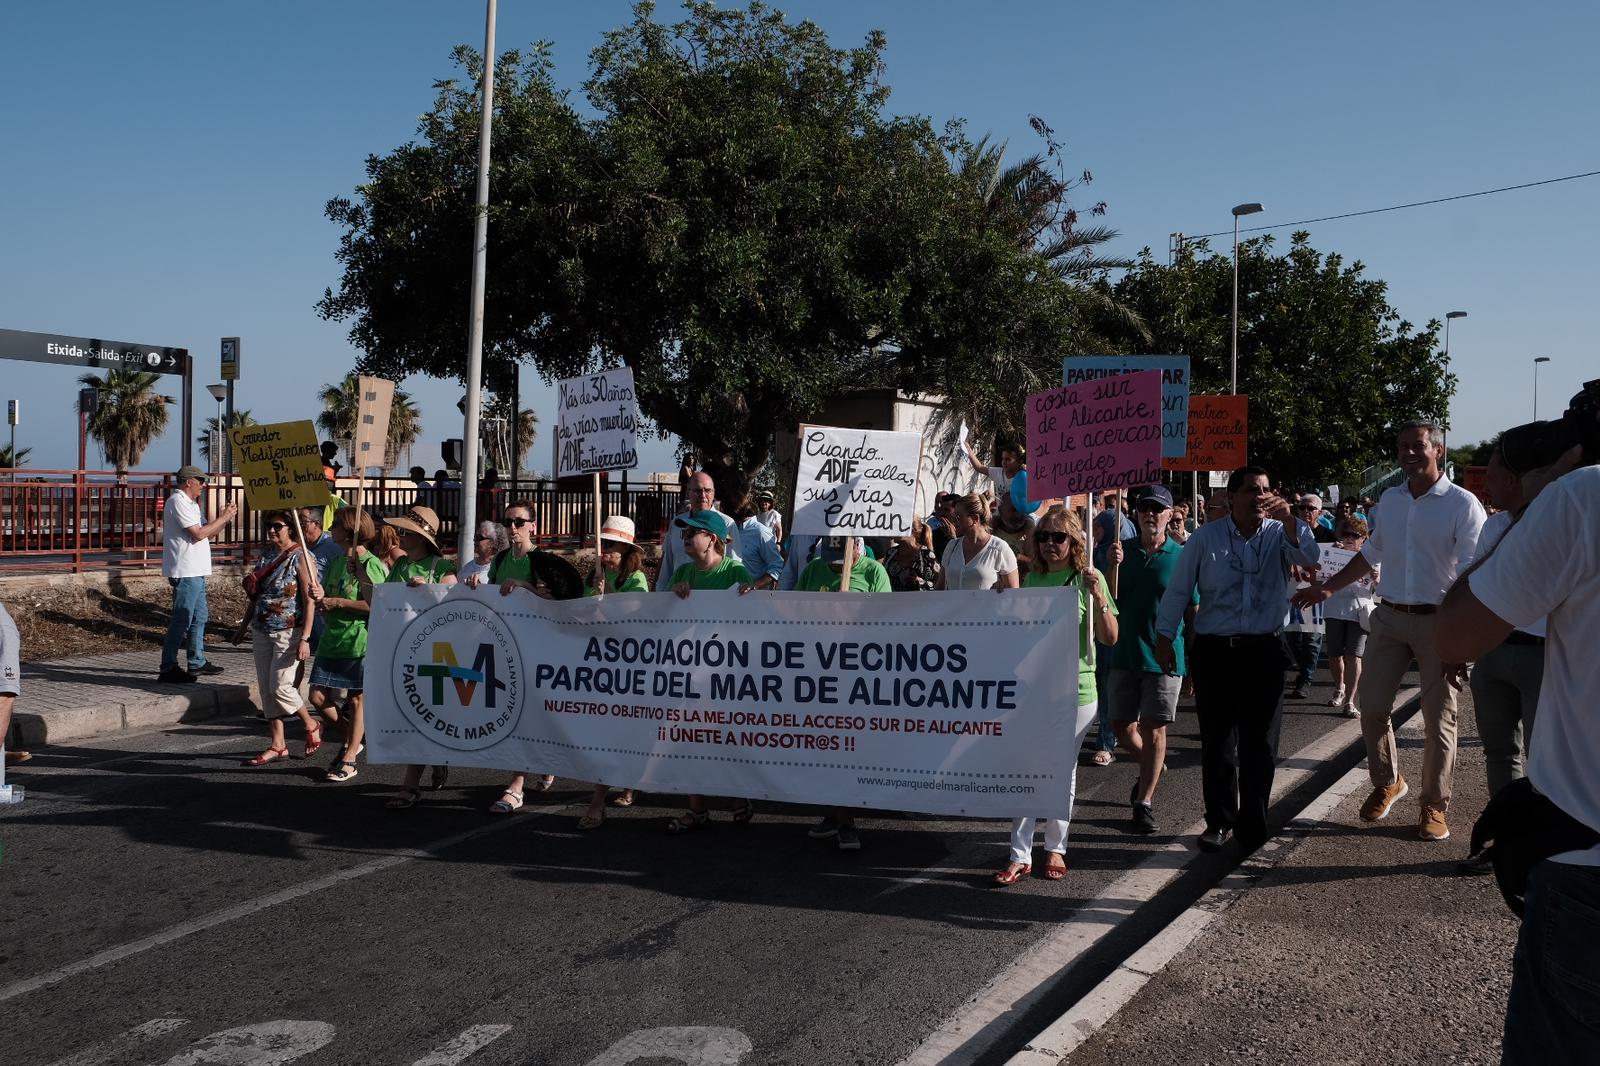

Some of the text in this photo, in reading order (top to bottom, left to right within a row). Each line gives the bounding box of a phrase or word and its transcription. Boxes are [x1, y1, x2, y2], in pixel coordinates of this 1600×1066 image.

[47, 343, 144, 364] Eixida Salida Exit
[559, 375, 633, 410] Más de 30 años
[1036, 380, 1135, 413] costa sur
[559, 405, 635, 439] de vías muertas
[1038, 399, 1155, 434] de Alicante,
[1188, 403, 1230, 419] metros
[233, 428, 281, 446] Corredor
[806, 431, 883, 461] Cuando...
[1083, 424, 1161, 448] acercas
[240, 442, 319, 464] Mediterráneo
[560, 437, 585, 472] ADIF
[815, 458, 914, 486] ADIF calla,
[1050, 452, 1115, 485] puedes
[249, 476, 271, 495] por
[275, 472, 289, 485] la
[279, 488, 296, 500] NO.
[803, 488, 838, 502] sus
[824, 504, 910, 532] Cantan
[464, 611, 477, 621] DE
[478, 614, 508, 648] VECINOS
[584, 633, 967, 673] ASOCIACIÓN DE VECINOS
[402, 656, 517, 740] PARQUE DEL MAR DE ALICANTE
[536, 663, 1017, 709] PARQUE DEL MAR DE ALICANTE
[544, 700, 1002, 736] NUESTRO OBJETIVO ES LA MEJORA DEL ACCESO SUR DE ALICANTE
[670, 725, 723, 744] ÚNETE
[725, 730, 737, 746] A
[741, 731, 839, 751] NOSOTR@S
[844, 736, 855, 752] !!
[857, 776, 1035, 794] www.avparquedelmaralicante.com
